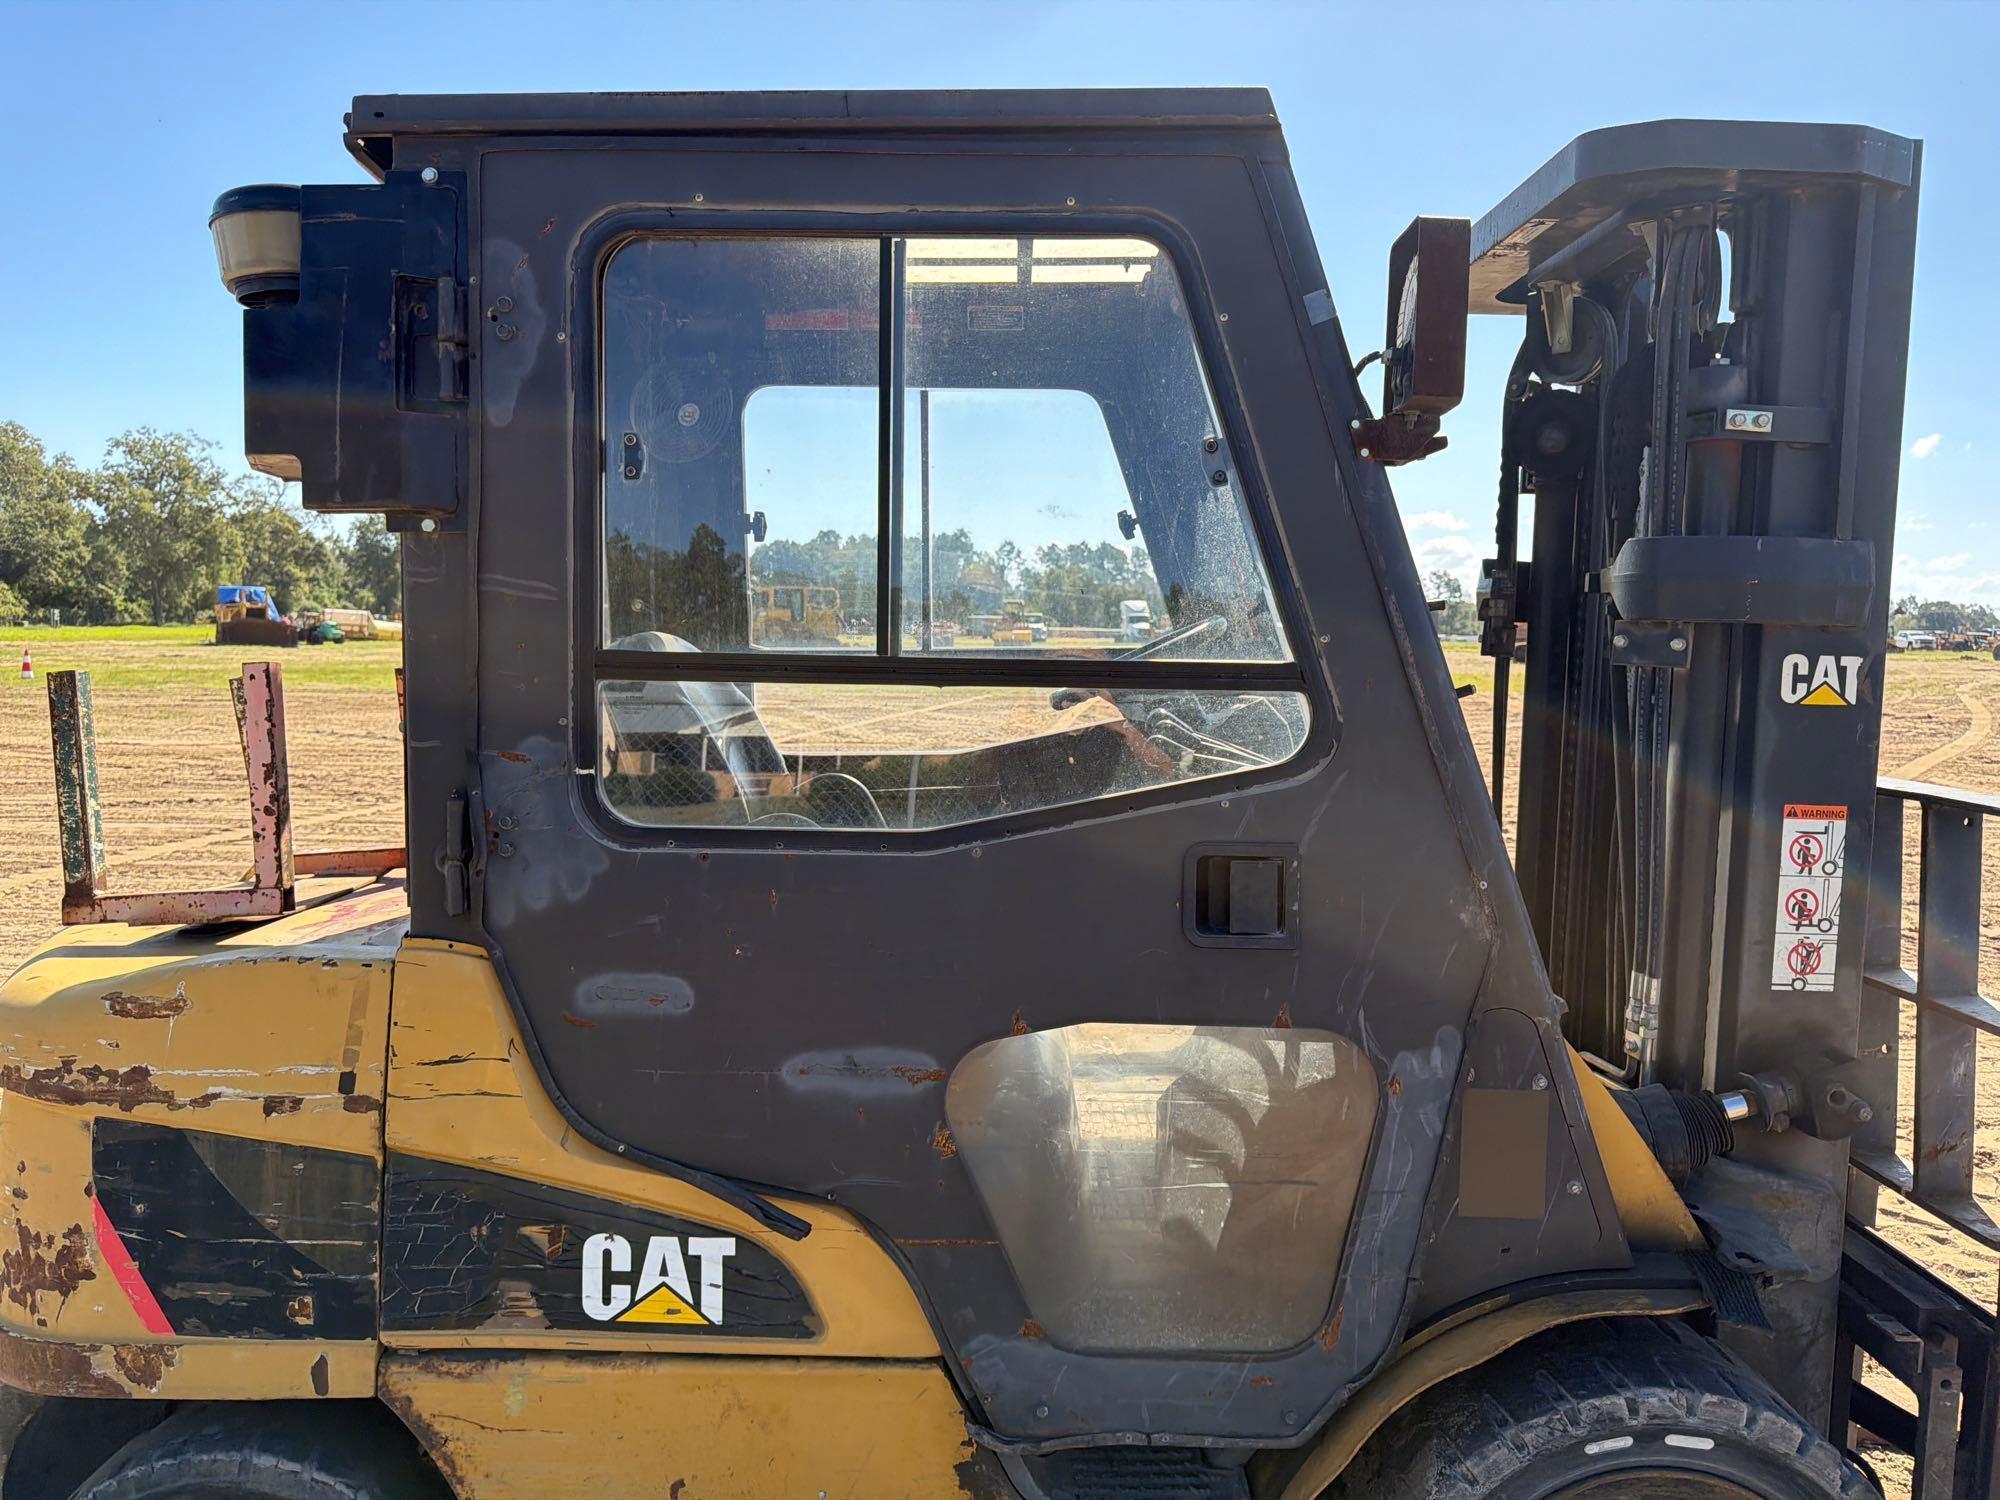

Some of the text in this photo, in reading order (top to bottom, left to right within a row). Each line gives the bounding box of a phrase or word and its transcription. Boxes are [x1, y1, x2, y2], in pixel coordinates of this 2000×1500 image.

[1780, 653, 1864, 706] CAT
[1800, 808, 1845, 819] WARNING
[581, 1232, 737, 1326] CAT
